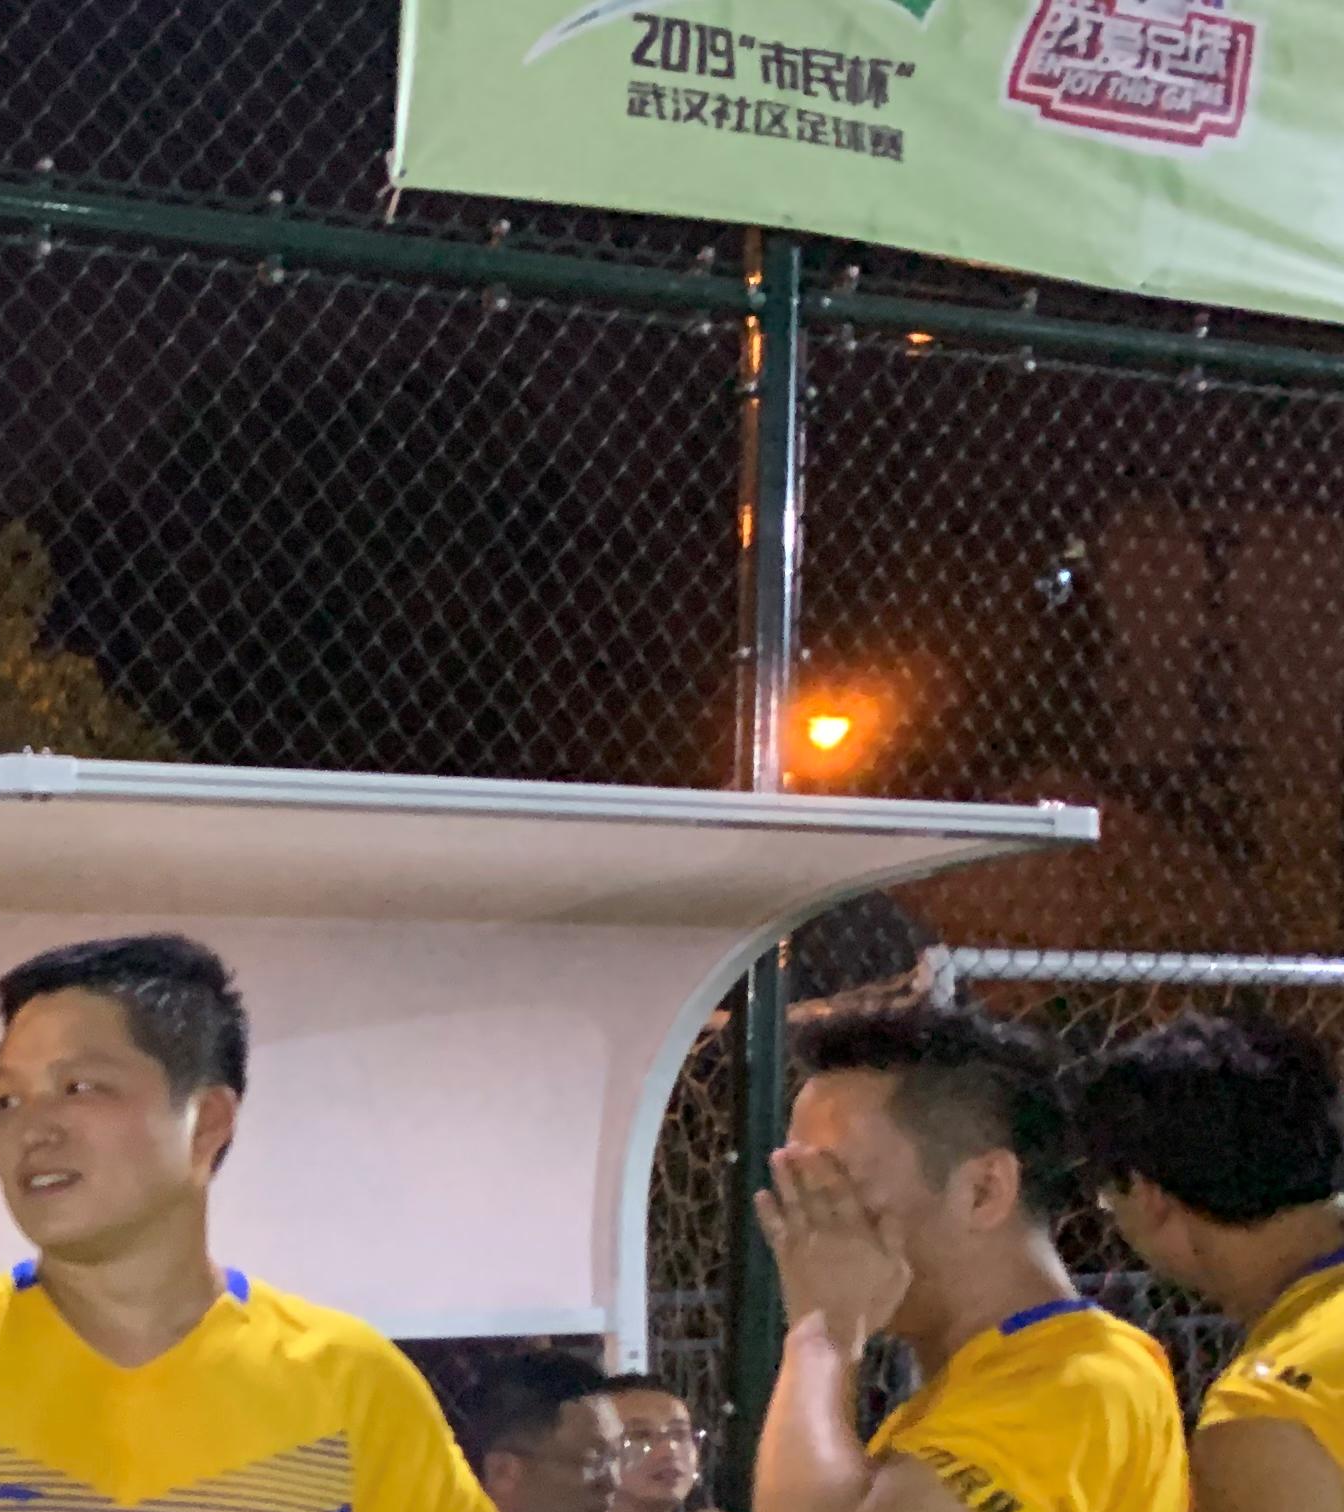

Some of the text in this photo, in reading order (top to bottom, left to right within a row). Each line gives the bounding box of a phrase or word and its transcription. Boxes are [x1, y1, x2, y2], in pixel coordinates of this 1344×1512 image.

[627, 80, 904, 162] 武汉社区足球赛
